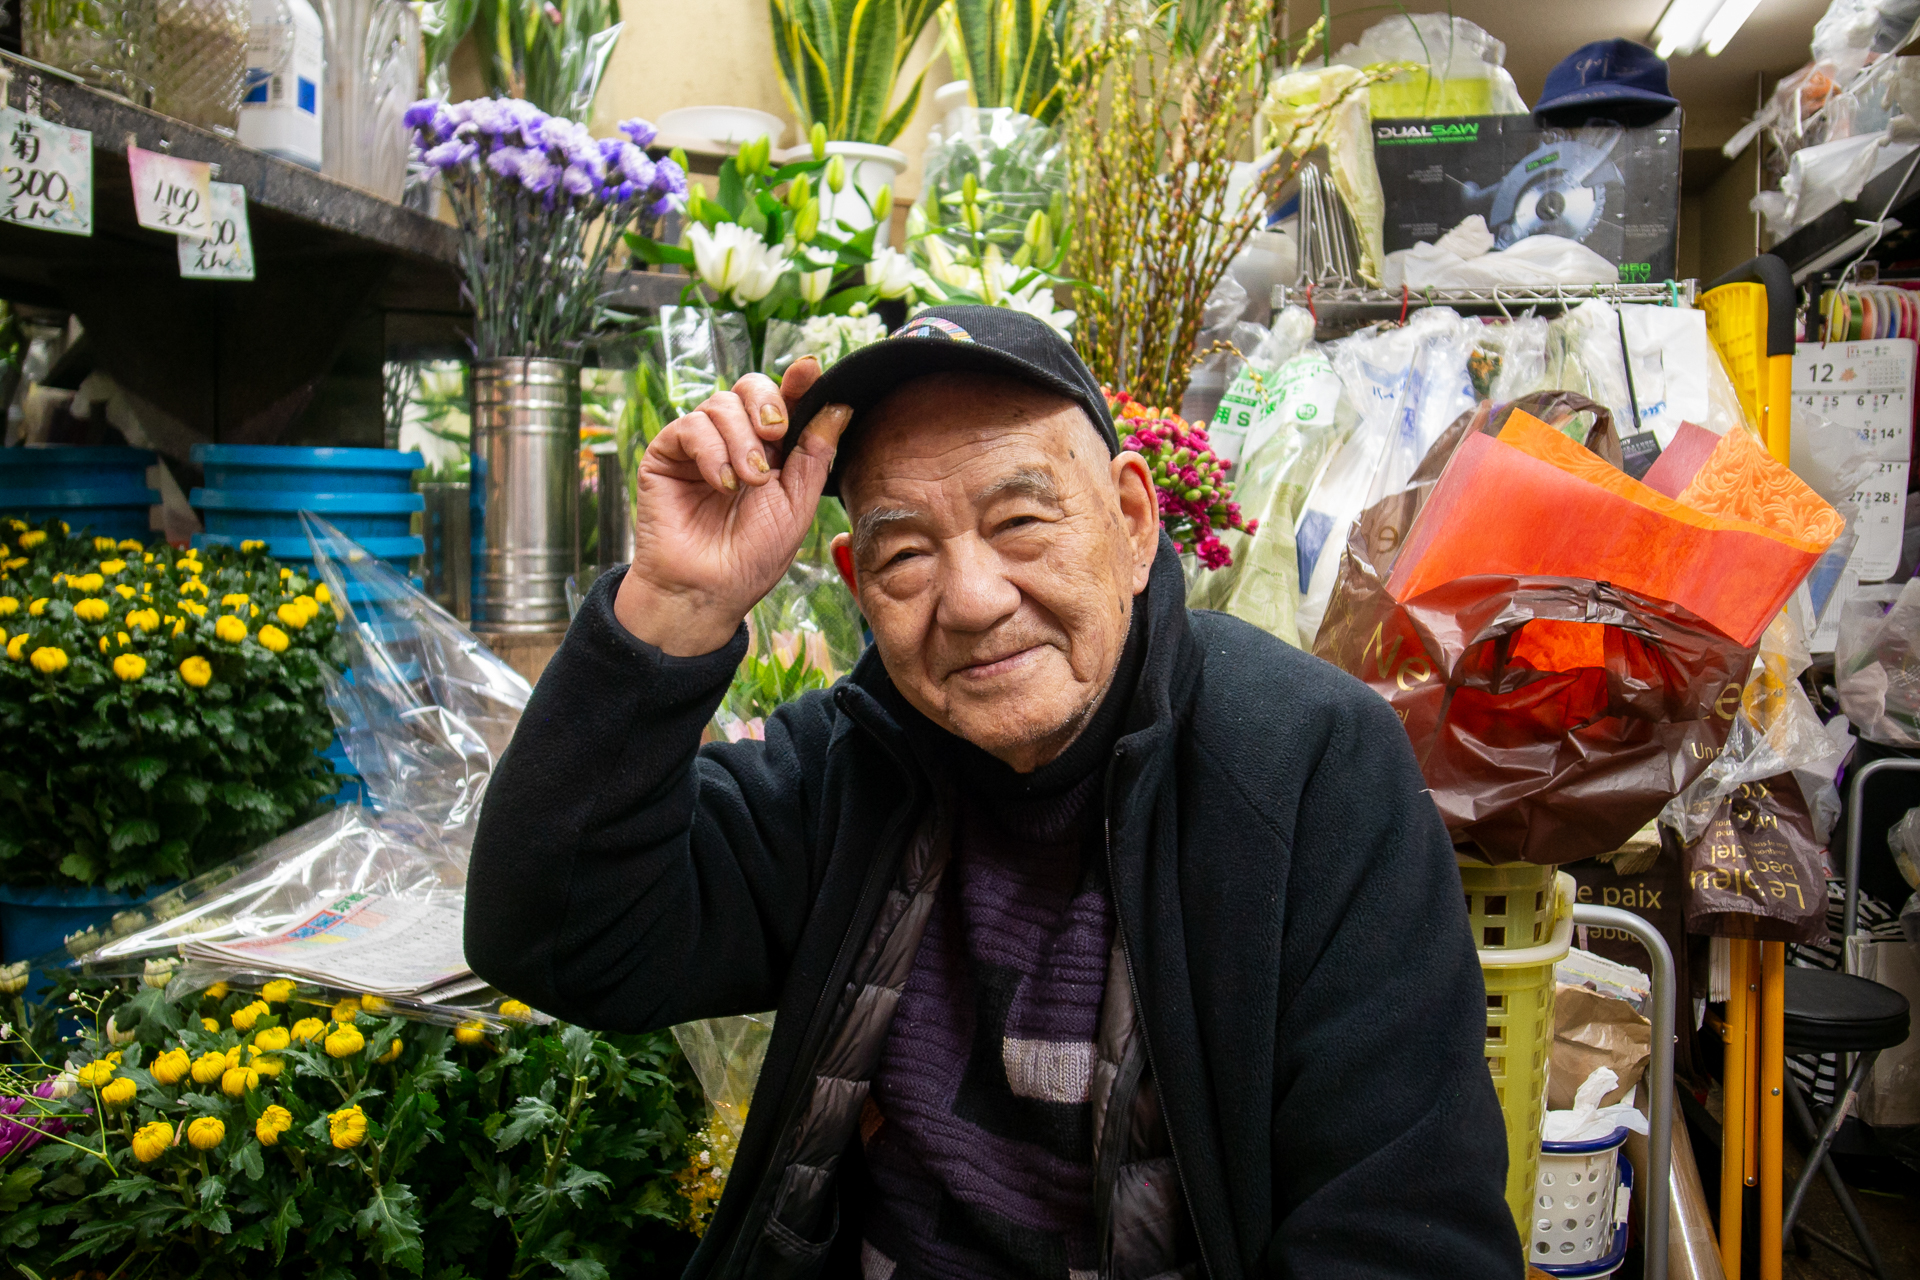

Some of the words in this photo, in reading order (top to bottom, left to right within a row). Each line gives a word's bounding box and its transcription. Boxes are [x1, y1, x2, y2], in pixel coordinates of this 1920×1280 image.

[1377, 122, 1480, 139] DUALSAW
[10, 118, 40, 163] 菊
[7, 166, 68, 202] 300
[1, 199, 57, 221] えん
[158, 210, 206, 230] えん
[1809, 363, 1834, 382] 12
[1805, 396, 1813, 406] 4
[1831, 396, 1839, 407] 5
[1857, 395, 1865, 406] 6
[1881, 394, 1889, 405] 7
[1880, 428, 1895, 439] 14
[1879, 463, 1892, 473] 21
[1874, 492, 1891, 502] 28
[1602, 882, 1662, 910] paix
[1768, 880, 1806, 910] Le
